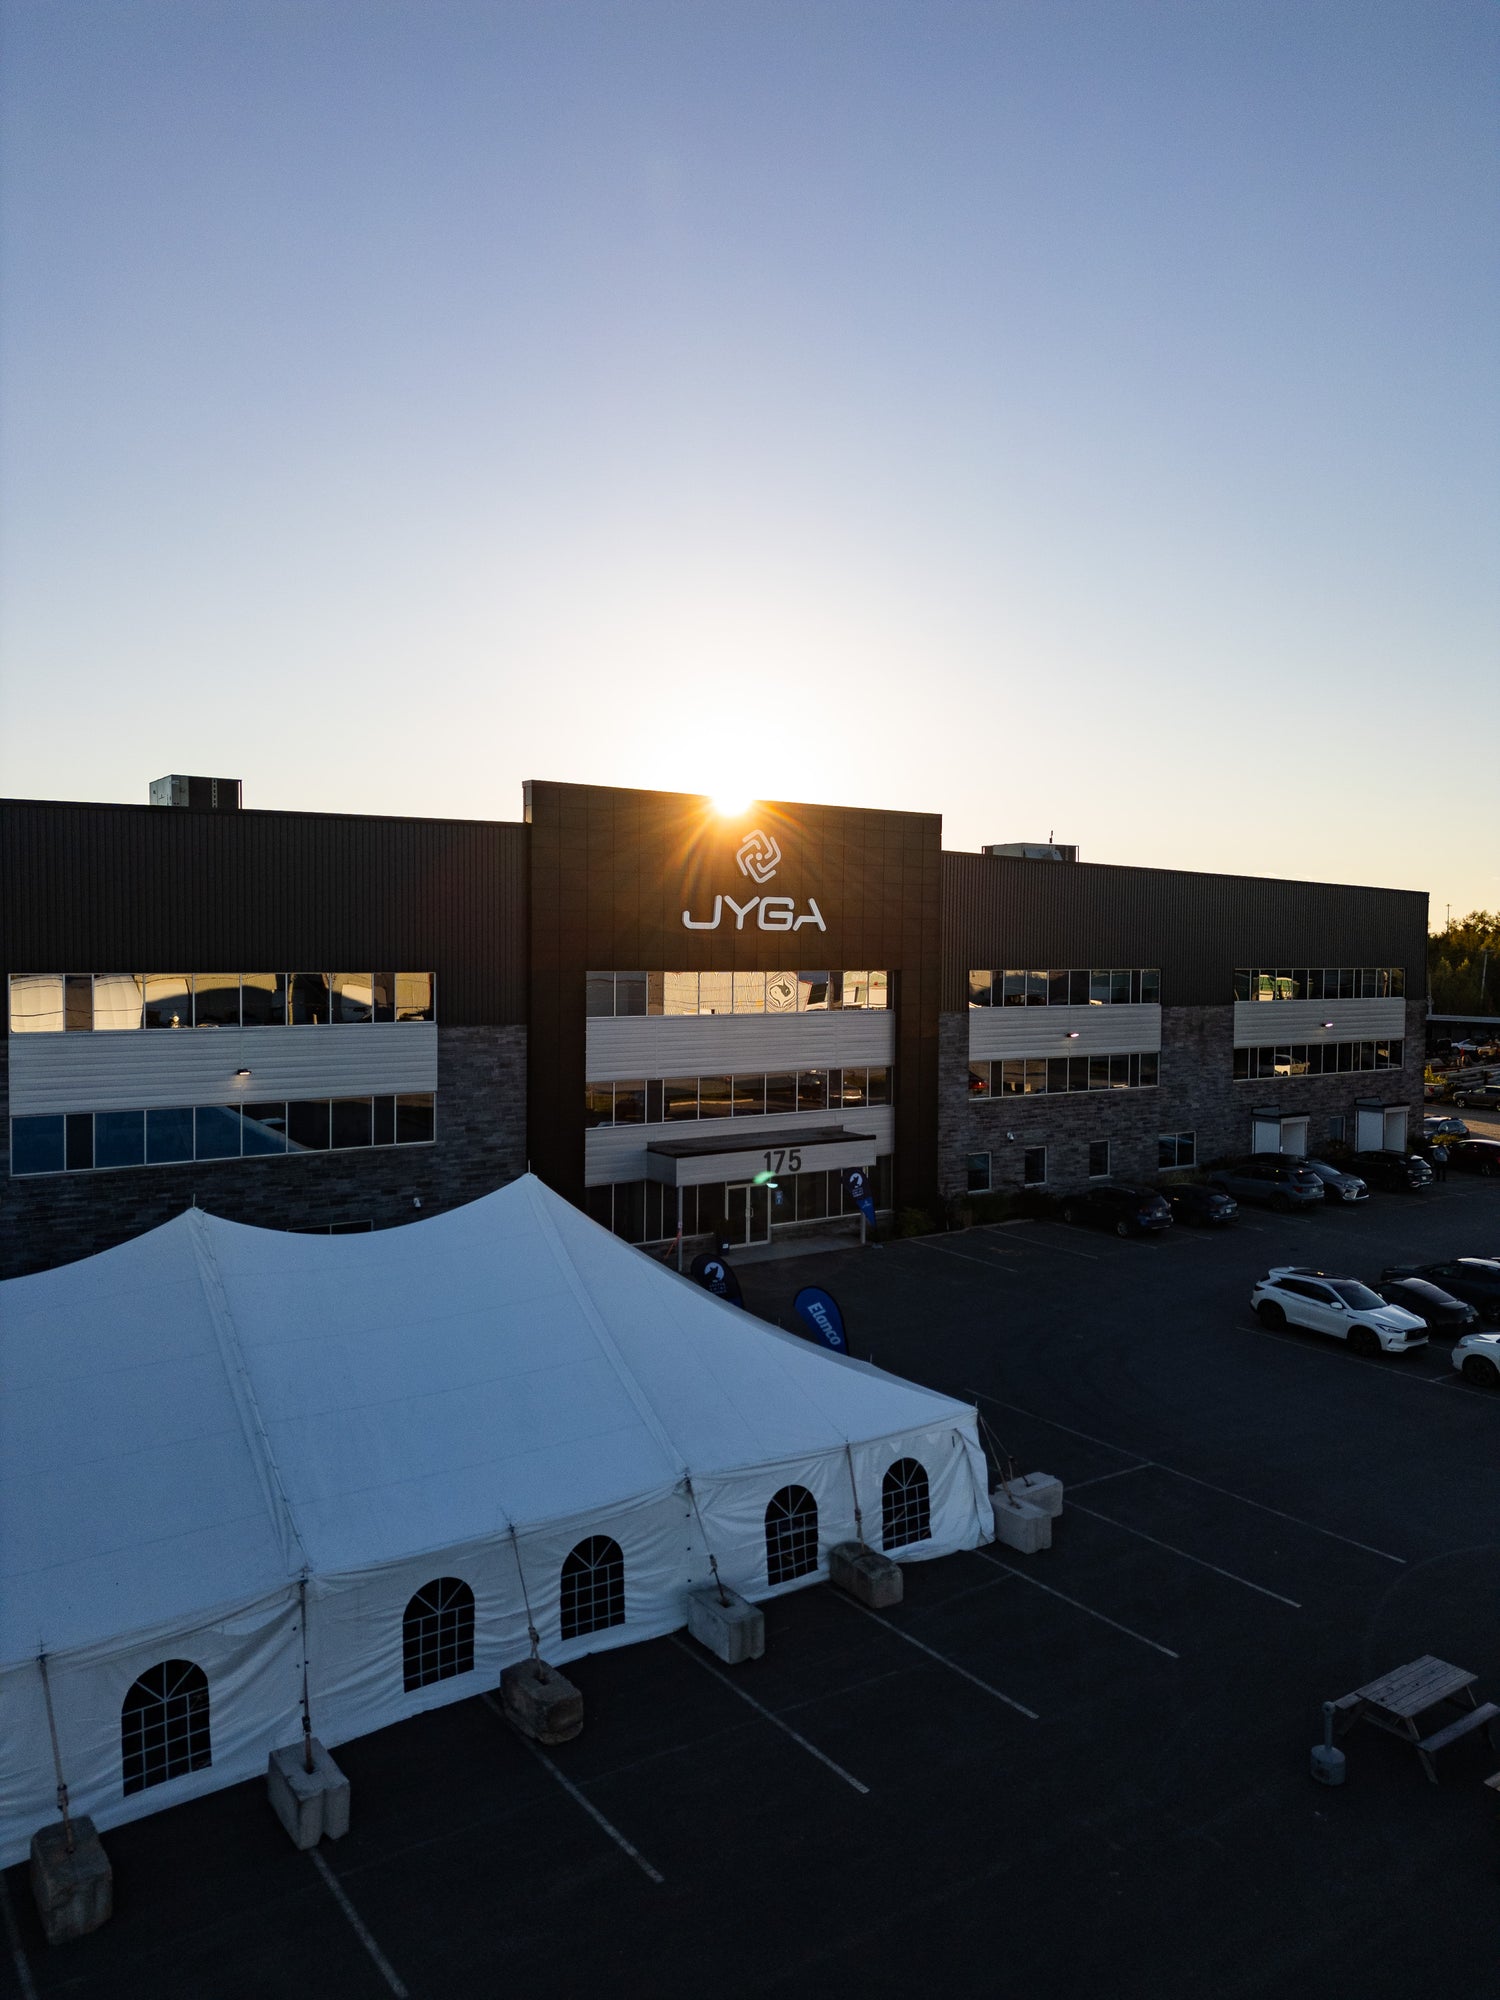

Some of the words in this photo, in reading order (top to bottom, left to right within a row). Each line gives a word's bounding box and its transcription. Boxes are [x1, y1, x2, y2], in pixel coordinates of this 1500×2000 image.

[682, 895, 826, 932] JYGA
[764, 1149, 801, 1174] 175
[807, 1302, 841, 1345] Elanco
